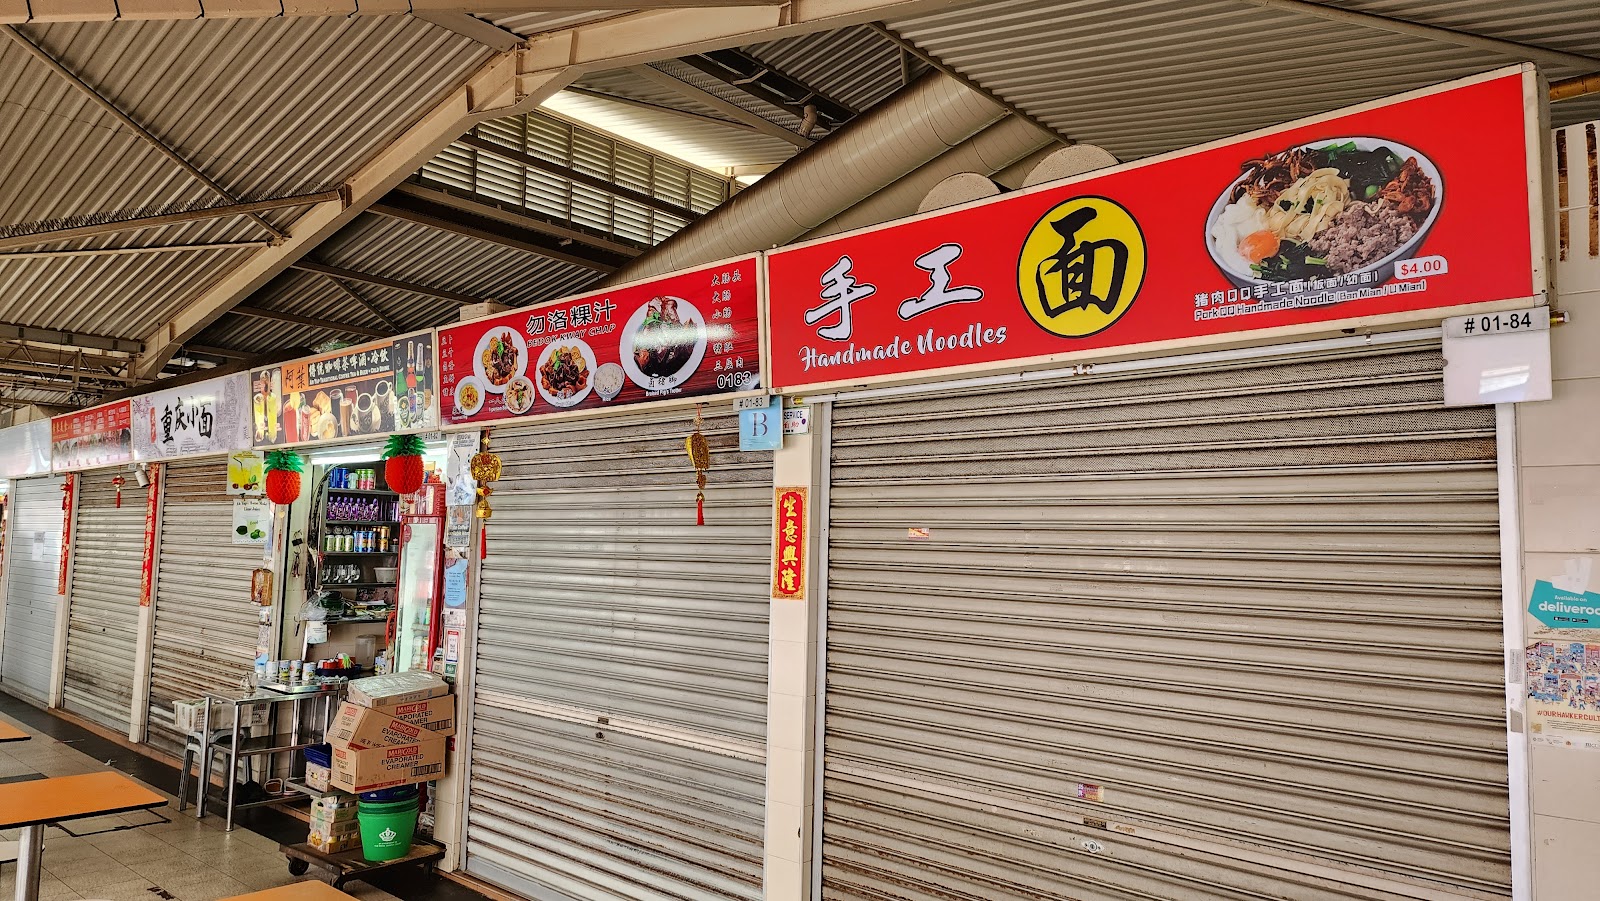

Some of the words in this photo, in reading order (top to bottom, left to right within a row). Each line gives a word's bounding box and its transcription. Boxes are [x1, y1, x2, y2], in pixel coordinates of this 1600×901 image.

[1401, 260, 1441, 276] $4.00
[1195, 308, 1218, 321] Pork
[1237, 297, 1294, 315] Handmade
[1294, 290, 1336, 308] Noodle
[1359, 287, 1382, 300] Mian
[526, 299, 617, 335] 勿洛粿汁
[1464, 317, 1476, 334] #
[1480, 312, 1532, 332] 01-84
[527, 335, 558, 348] BEDOK
[560, 329, 587, 342] KWAY
[588, 323, 616, 336] CHAP
[798, 336, 913, 372] Handmade
[916, 322, 1008, 354] Noodles
[717, 371, 752, 388] 0183
[745, 397, 763, 408] 01-83
[752, 412, 768, 436] B
[781, 495, 798, 591] 生意興隆
[397, 703, 427, 715] MARIGOLD
[397, 711, 433, 721] APORATED
[389, 720, 420, 737] MARIGOLD
[384, 735, 406, 745] CREA
[381, 754, 424, 765] EVAPORATED
[387, 746, 418, 758] MARIGOLD
[387, 761, 419, 771] CREAMER
